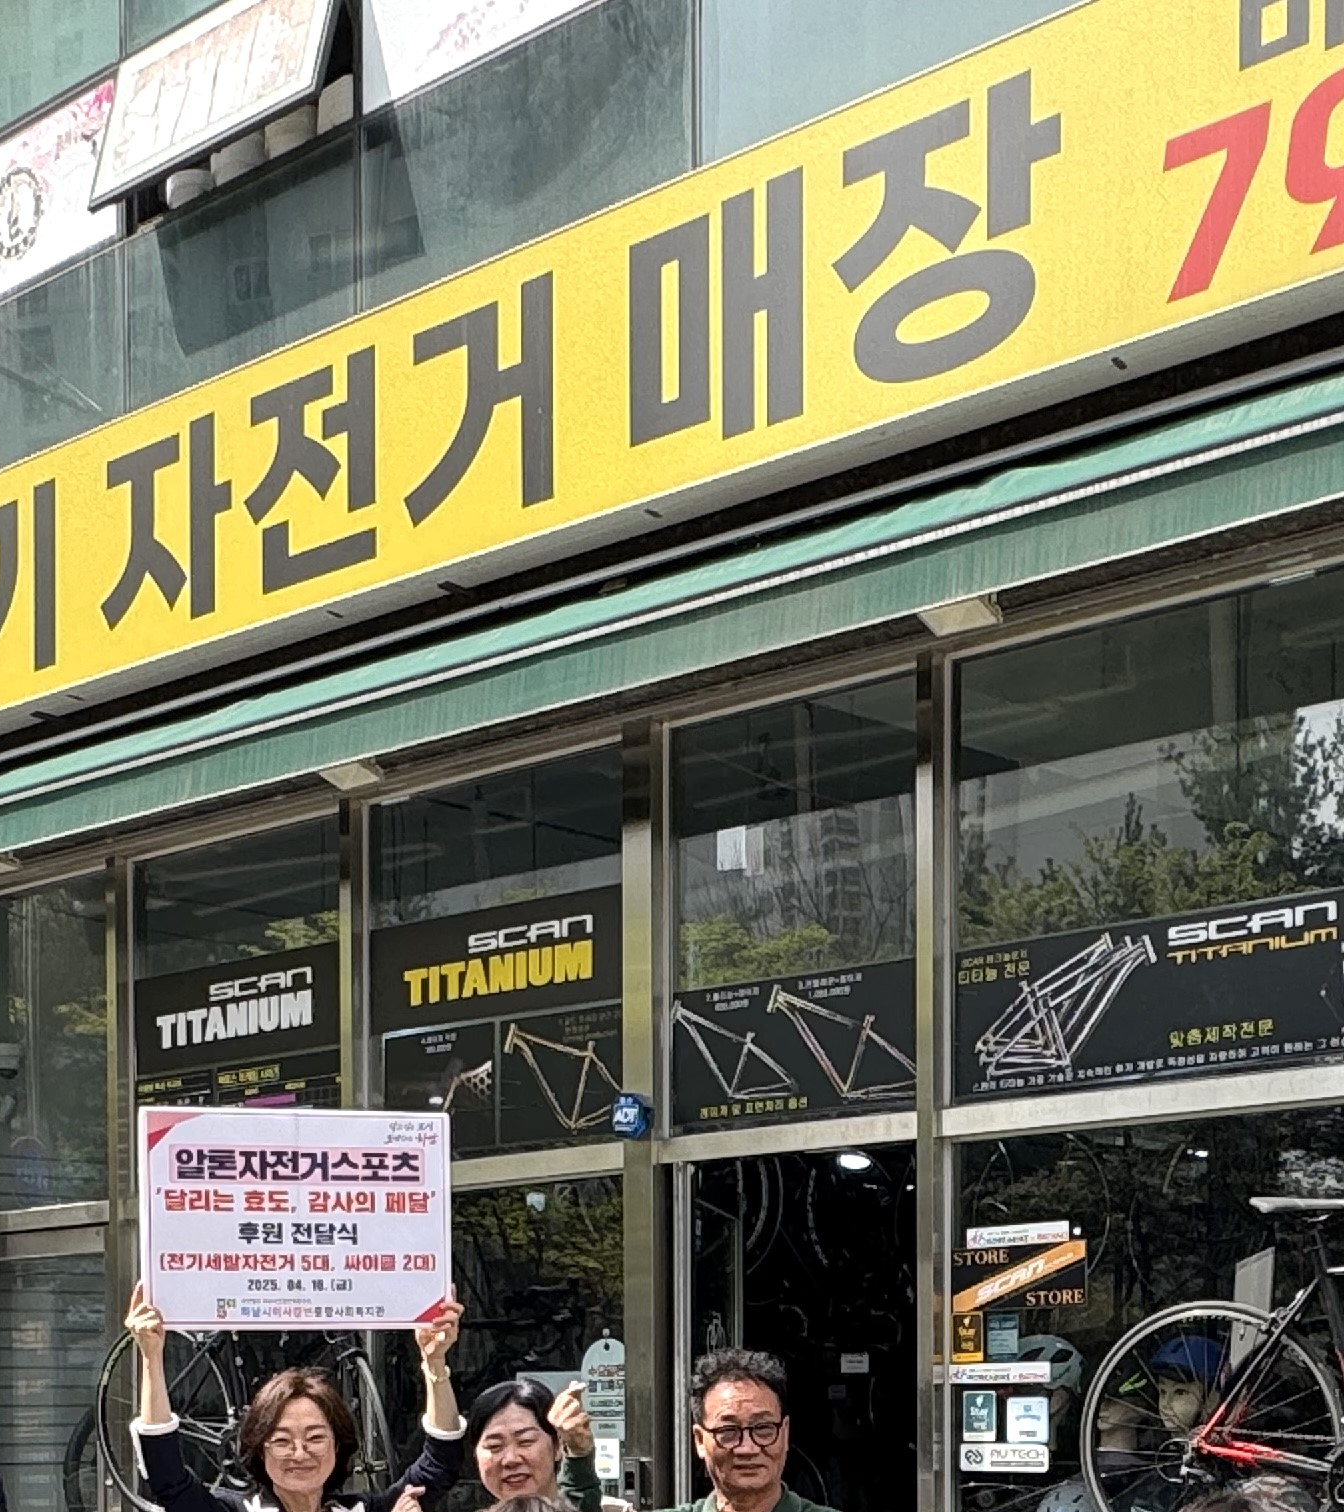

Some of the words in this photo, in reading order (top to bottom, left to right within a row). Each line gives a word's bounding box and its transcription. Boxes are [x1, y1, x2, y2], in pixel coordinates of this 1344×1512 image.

[99, 271, 560, 631] 자전거
[628, 69, 1063, 448] 매장
[468, 914, 594, 954] SCAN
[1166, 899, 1338, 943] SCAN
[1166, 926, 1338, 965] TITANIUM
[208, 966, 313, 1002] SCAN
[403, 941, 594, 1006] TITANIUM
[958, 967, 998, 985] 티타늄
[1004, 961, 1031, 978] 전문
[156, 988, 313, 1049] TITANIUM
[1168, 1019, 1274, 1048] 맞춤제작전문
[176, 1149, 421, 1182] 알톤자전거스포츠
[308, 1191, 375, 1213] 감사의
[238, 1221, 283, 1244] 후원
[291, 1222, 358, 1245] 전달식
[953, 1249, 1010, 1267] STORE
[1025, 1288, 1084, 1306] STORE
